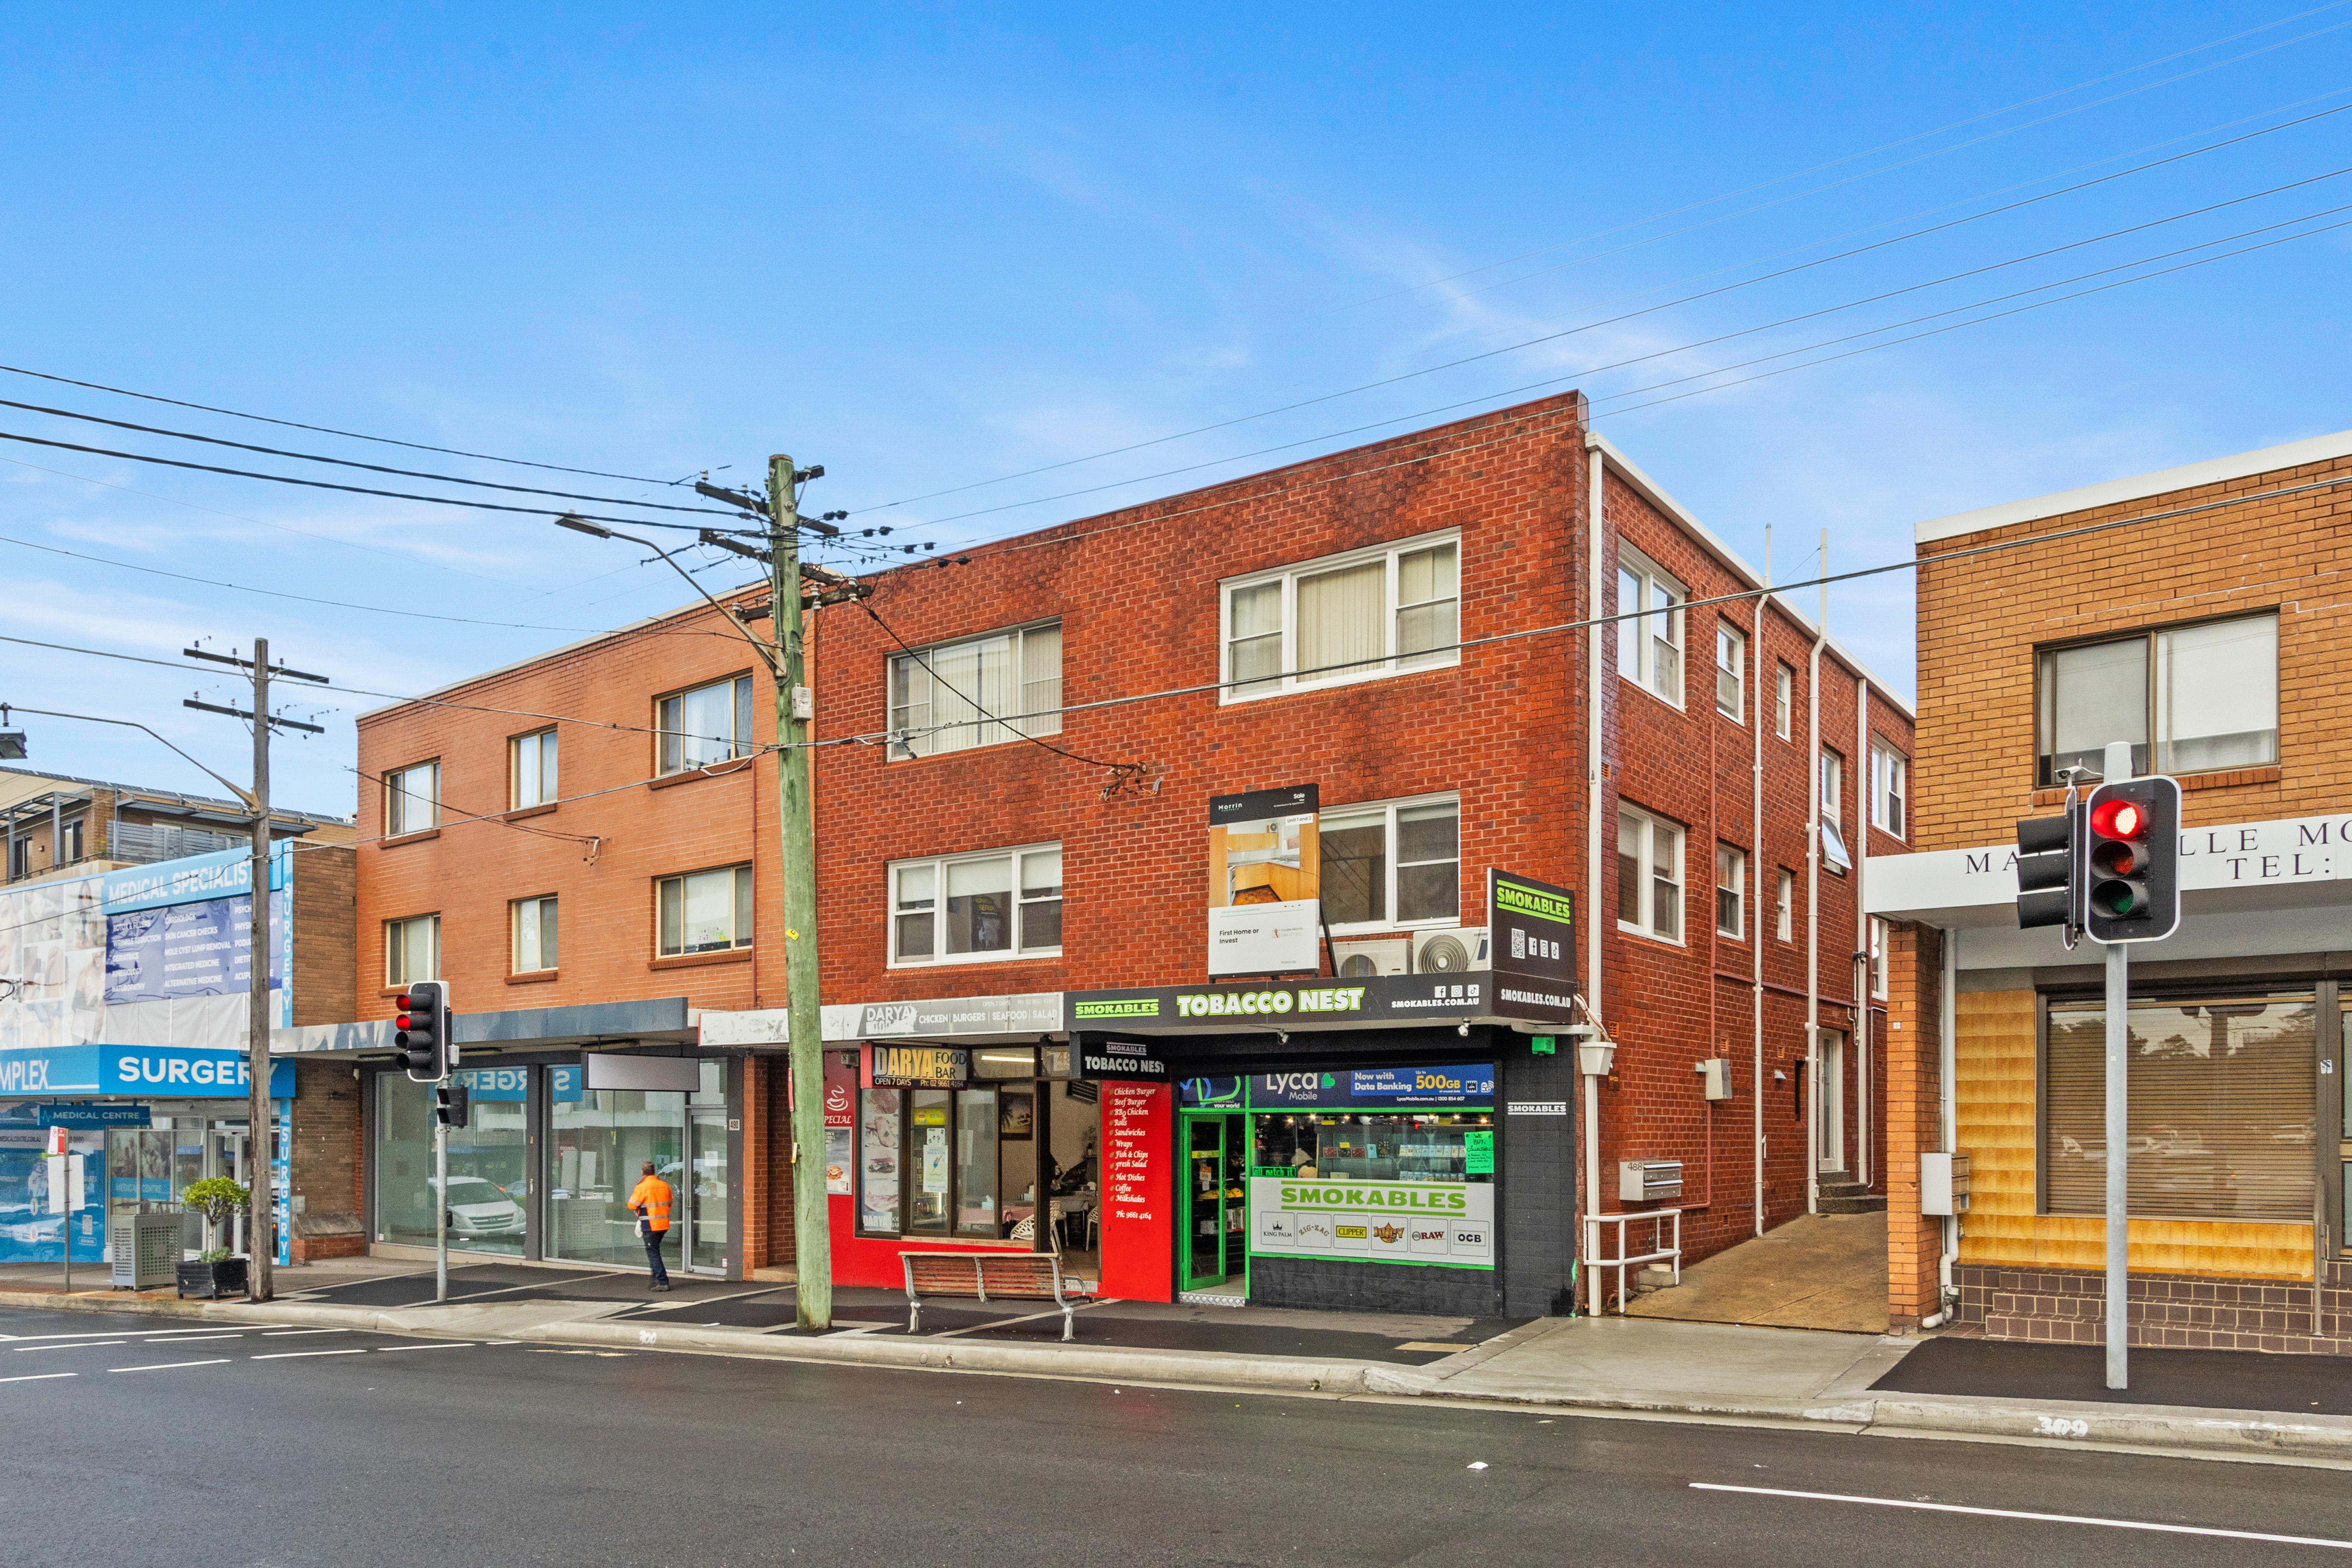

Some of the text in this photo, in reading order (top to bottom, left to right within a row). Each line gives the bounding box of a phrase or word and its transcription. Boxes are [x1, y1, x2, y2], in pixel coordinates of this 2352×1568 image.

[2226, 853, 2330, 880] TEL:
[109, 876, 168, 906] MEDICAL
[1497, 887, 1570, 918] SMOKABLES
[165, 913, 196, 925] CARDIOLOGY
[113, 923, 128, 932] BOTOX
[133, 919, 152, 929] FILLERS
[165, 926, 218, 940] SKIN CANCER CHECKS
[112, 934, 161, 947] WRINKLE REDUCTION
[165, 940, 232, 956] MOLE CYST LUMP REMOVAL
[283, 882, 292, 1011] SURGERY
[112, 952, 140, 962] GERIATRICS
[164, 958, 220, 972] INTEGRATED MEDICINE
[111, 968, 143, 978] KINESIOLOGY
[164, 974, 223, 987] ALTERNATIVE MEDICINE
[111, 982, 146, 992] NATUROPATHY
[1177, 986, 1366, 1017] TOBACCO NEST
[1391, 997, 1480, 1009] SMOKABLES.COM.AU
[1501, 988, 1571, 1008] SMOKABLES.COM.AU
[866, 1006, 911, 1022] DARYA
[1075, 1003, 1159, 1015] SMOKABLES
[919, 1009, 1058, 1024] CHICKEN BURGERS SEAFOOD SALAD
[1106, 1043, 1147, 1054] SMOKABLES
[874, 1047, 967, 1078] DARYA FOOD
[1084, 1056, 1165, 1073] TOBACCO NEST
[935, 1066, 956, 1079] BAR
[1375, 1072, 1395, 1080] with
[896, 1078, 912, 1086] DAYS
[920, 1078, 929, 1087] Ph:
[1266, 1072, 1318, 1094] Lyca
[1354, 1082, 1412, 1092] Data Banking
[1416, 1075, 1461, 1090] 500GB
[1114, 1087, 1156, 1097] Chicken Burger
[1289, 1091, 1318, 1100] Mobile
[1114, 1097, 1146, 1108] Beef Burger
[1127, 1107, 1149, 1115] Chicken
[1507, 1104, 1567, 1113] SMOKABLES
[730, 1120, 739, 1129] 490
[824, 1115, 851, 1124] PECIAL
[1114, 1128, 1146, 1136] Sandwiches
[1115, 1139, 1133, 1150] Wraps
[1115, 1150, 1127, 1159] Fish
[1133, 1150, 1148, 1160] Chips
[1115, 1159, 1131, 1170] Fresh
[1627, 1162, 1643, 1171] 488
[1127, 1173, 1145, 1181] Dishes
[1265, 1168, 1284, 1177] match
[1286, 1168, 1293, 1176] it
[280, 1127, 289, 1256] SURGERY
[1115, 1183, 1132, 1194] Coffee
[1115, 1194, 1145, 1203] Milkshakes
[1281, 1187, 1466, 1210] SMOKABLES
[1116, 1210, 1125, 1218] Ph:
[1139, 1212, 1152, 1220] 4164
[1298, 1224, 1329, 1237] ZIG-ZAG
[1338, 1228, 1365, 1236] CLIPPER
[1373, 1226, 1404, 1238] JUICY
[1421, 1231, 1445, 1240] RAW
[1458, 1233, 1482, 1243] OCB
